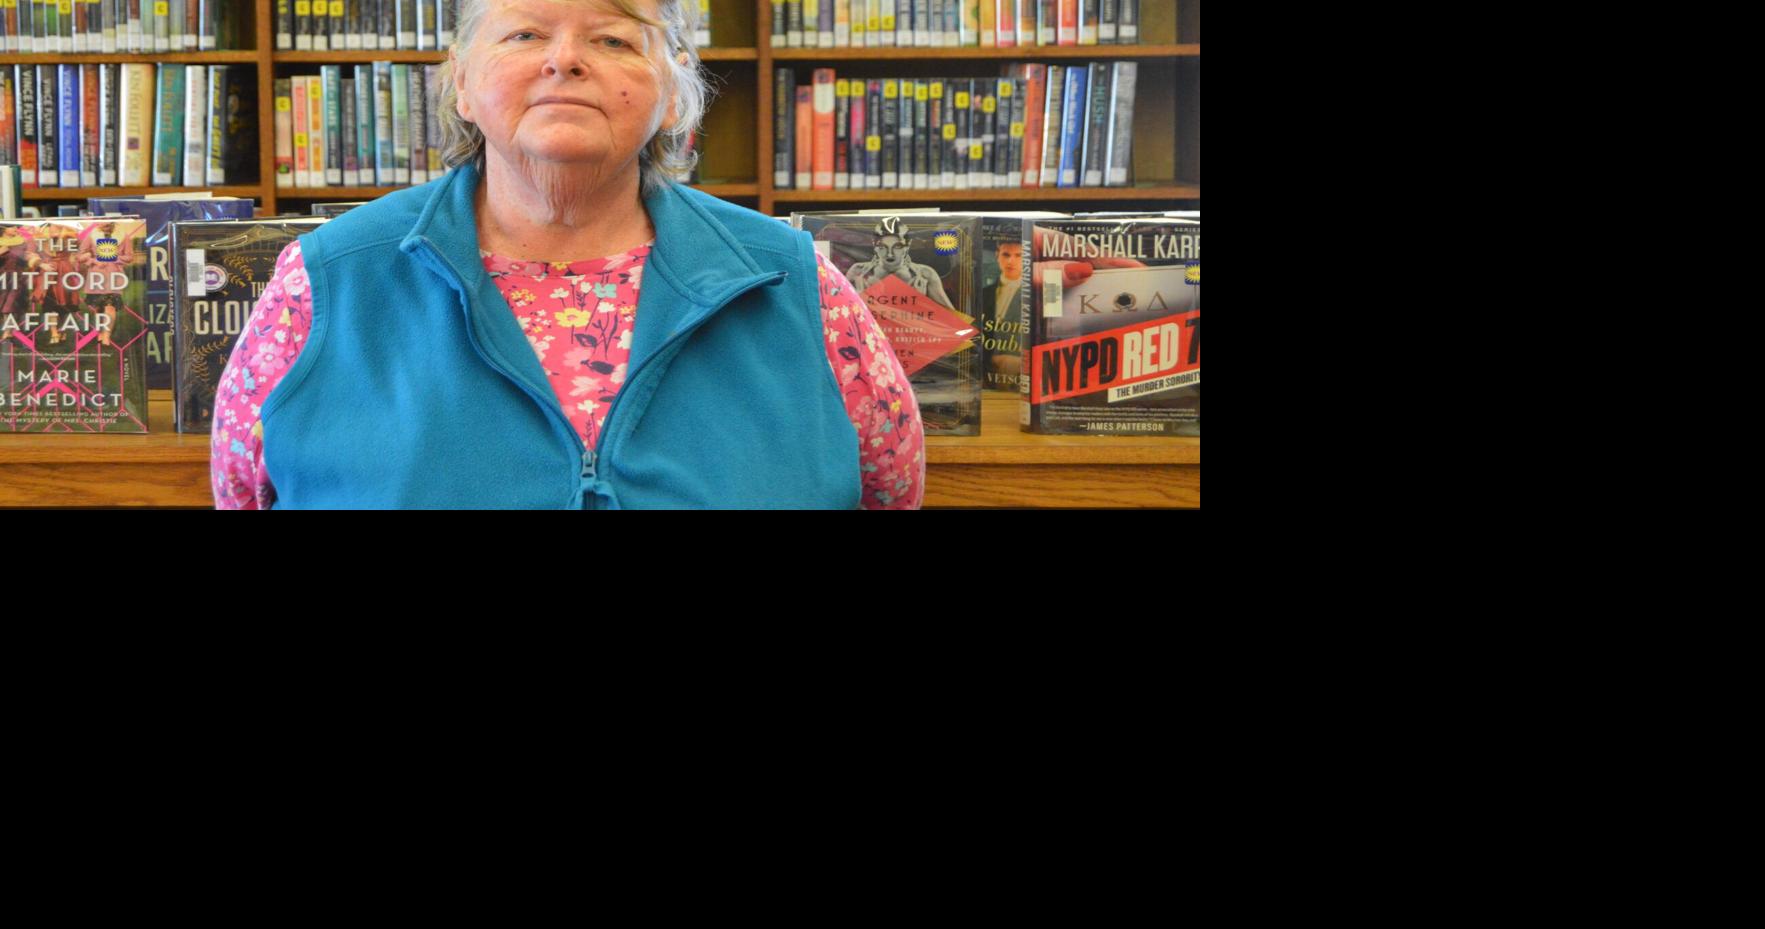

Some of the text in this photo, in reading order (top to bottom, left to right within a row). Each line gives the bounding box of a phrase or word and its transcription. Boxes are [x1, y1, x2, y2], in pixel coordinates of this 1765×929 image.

[22, 70, 33, 102] VINCE
[43, 78, 53, 106] VINCE
[63, 70, 72, 97] VINCE
[63, 99, 72, 126] FLYNN
[1095, 85, 1105, 124] HUSH
[23, 103, 34, 136] FLYNN
[44, 108, 53, 136] FLYNN
[35, 238, 79, 252] THE
[1042, 233, 1147, 259] MARSHALL
[1021, 240, 1031, 298] MARSHALL
[2, 313, 111, 331] AFFAIR
[983, 335, 1021, 351] oub
[1041, 337, 1118, 397] NYPD
[1122, 322, 1179, 380] RED
[18, 370, 97, 383] MARIE
[1116, 387, 1131, 398] THE
[1133, 379, 1164, 394] MURDER
[1116, 423, 1164, 431] PATTERSON
